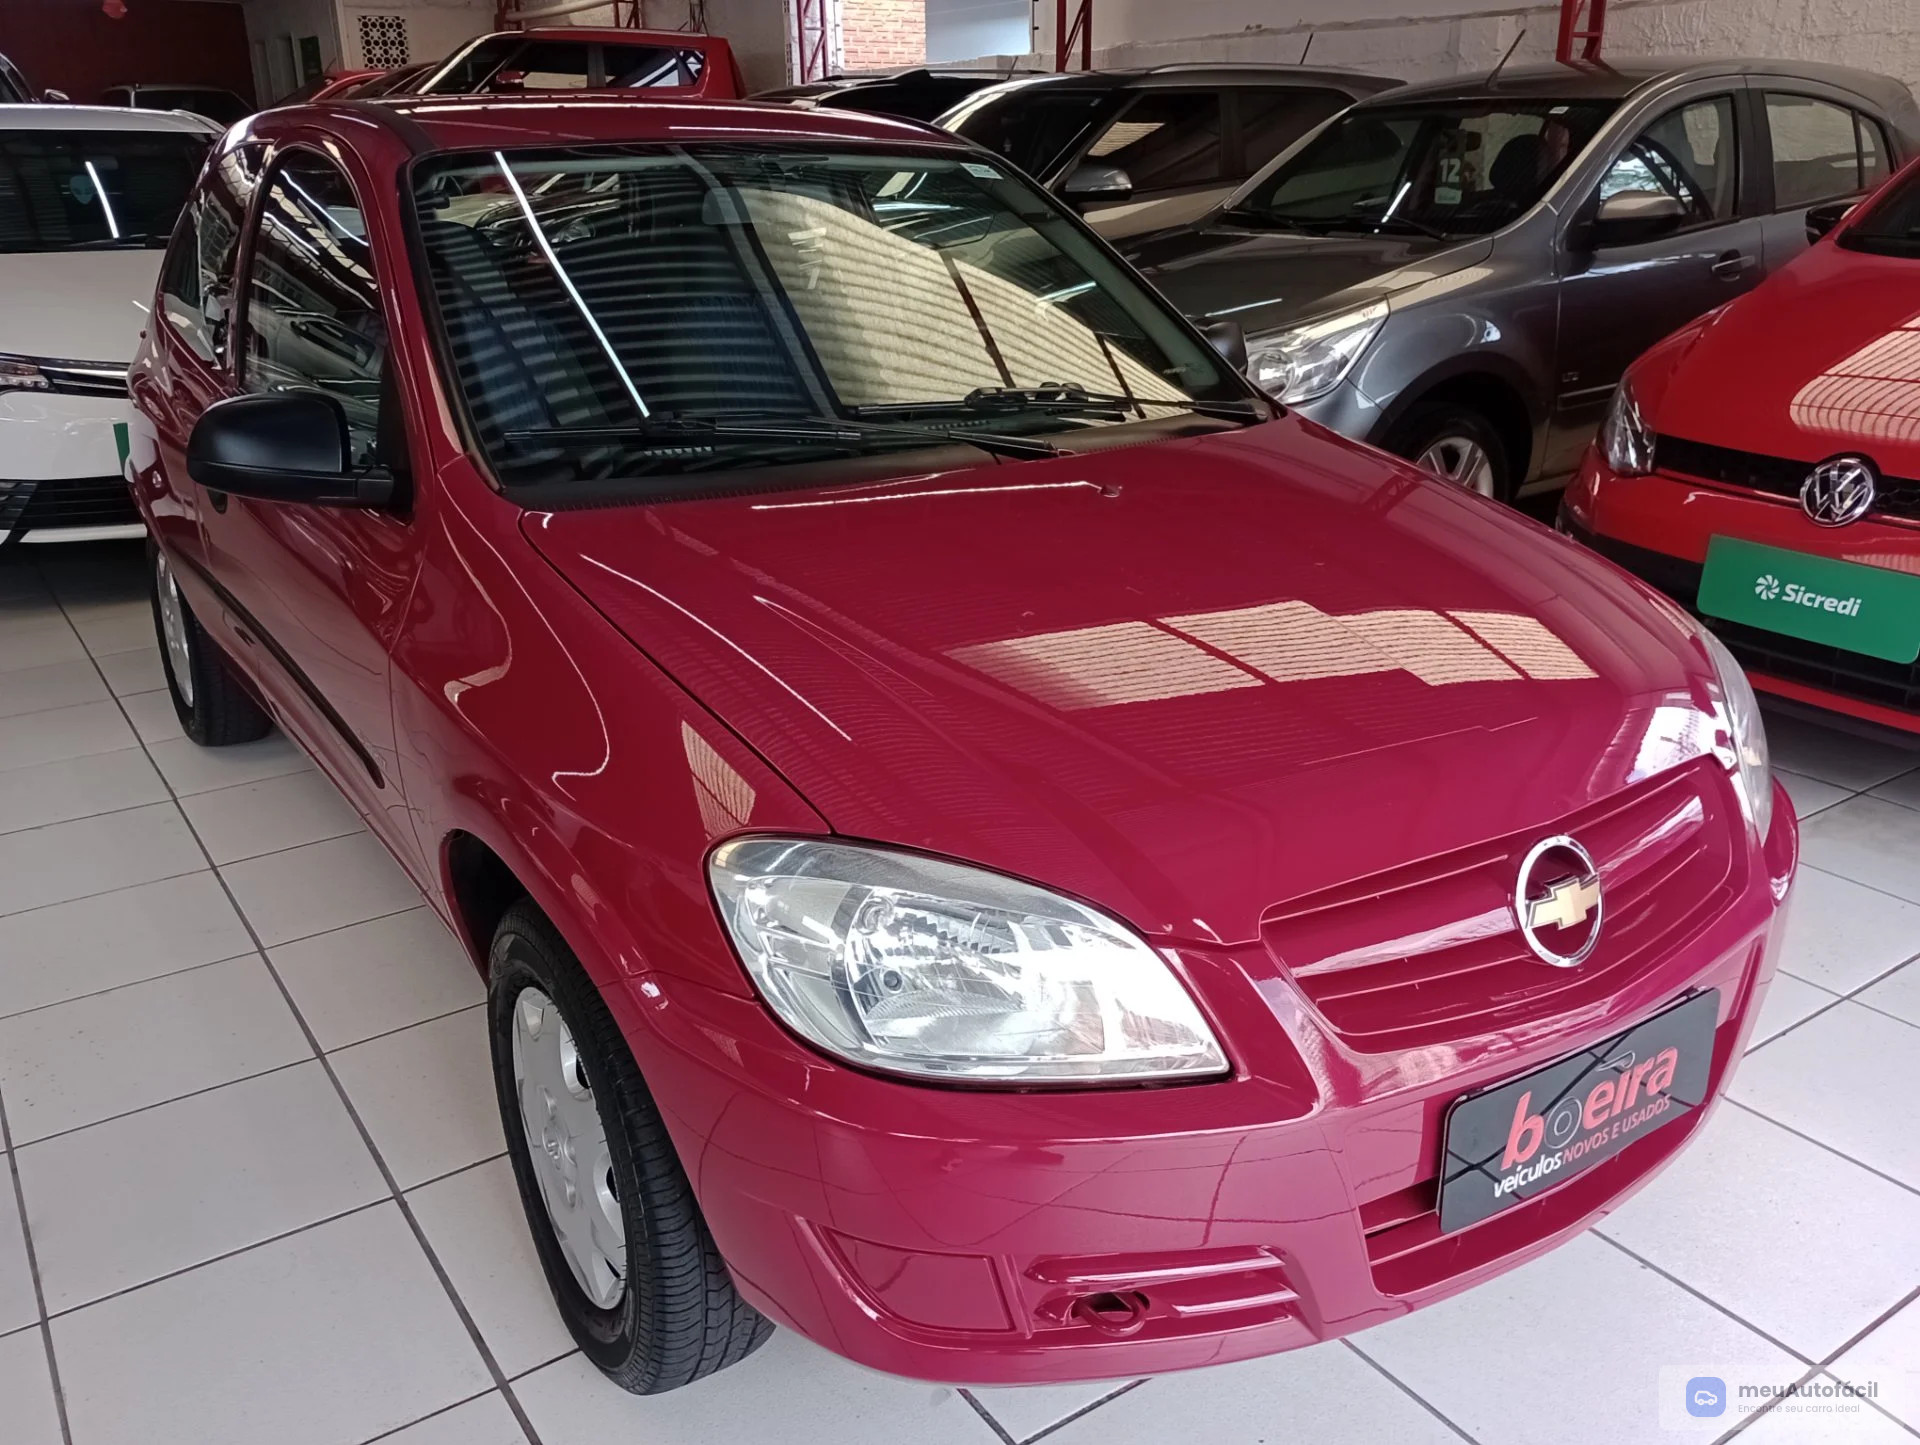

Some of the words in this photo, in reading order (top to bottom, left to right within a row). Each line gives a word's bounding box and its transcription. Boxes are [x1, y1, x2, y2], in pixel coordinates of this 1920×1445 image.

[1440, 158, 1461, 183] 12
[1782, 583, 1862, 617] Sicredi
[1500, 1047, 1678, 1171] boeira
[1563, 1130, 1609, 1165] NOVOS
[1611, 1122, 1621, 1140] E
[1622, 1094, 1672, 1133] USADOS
